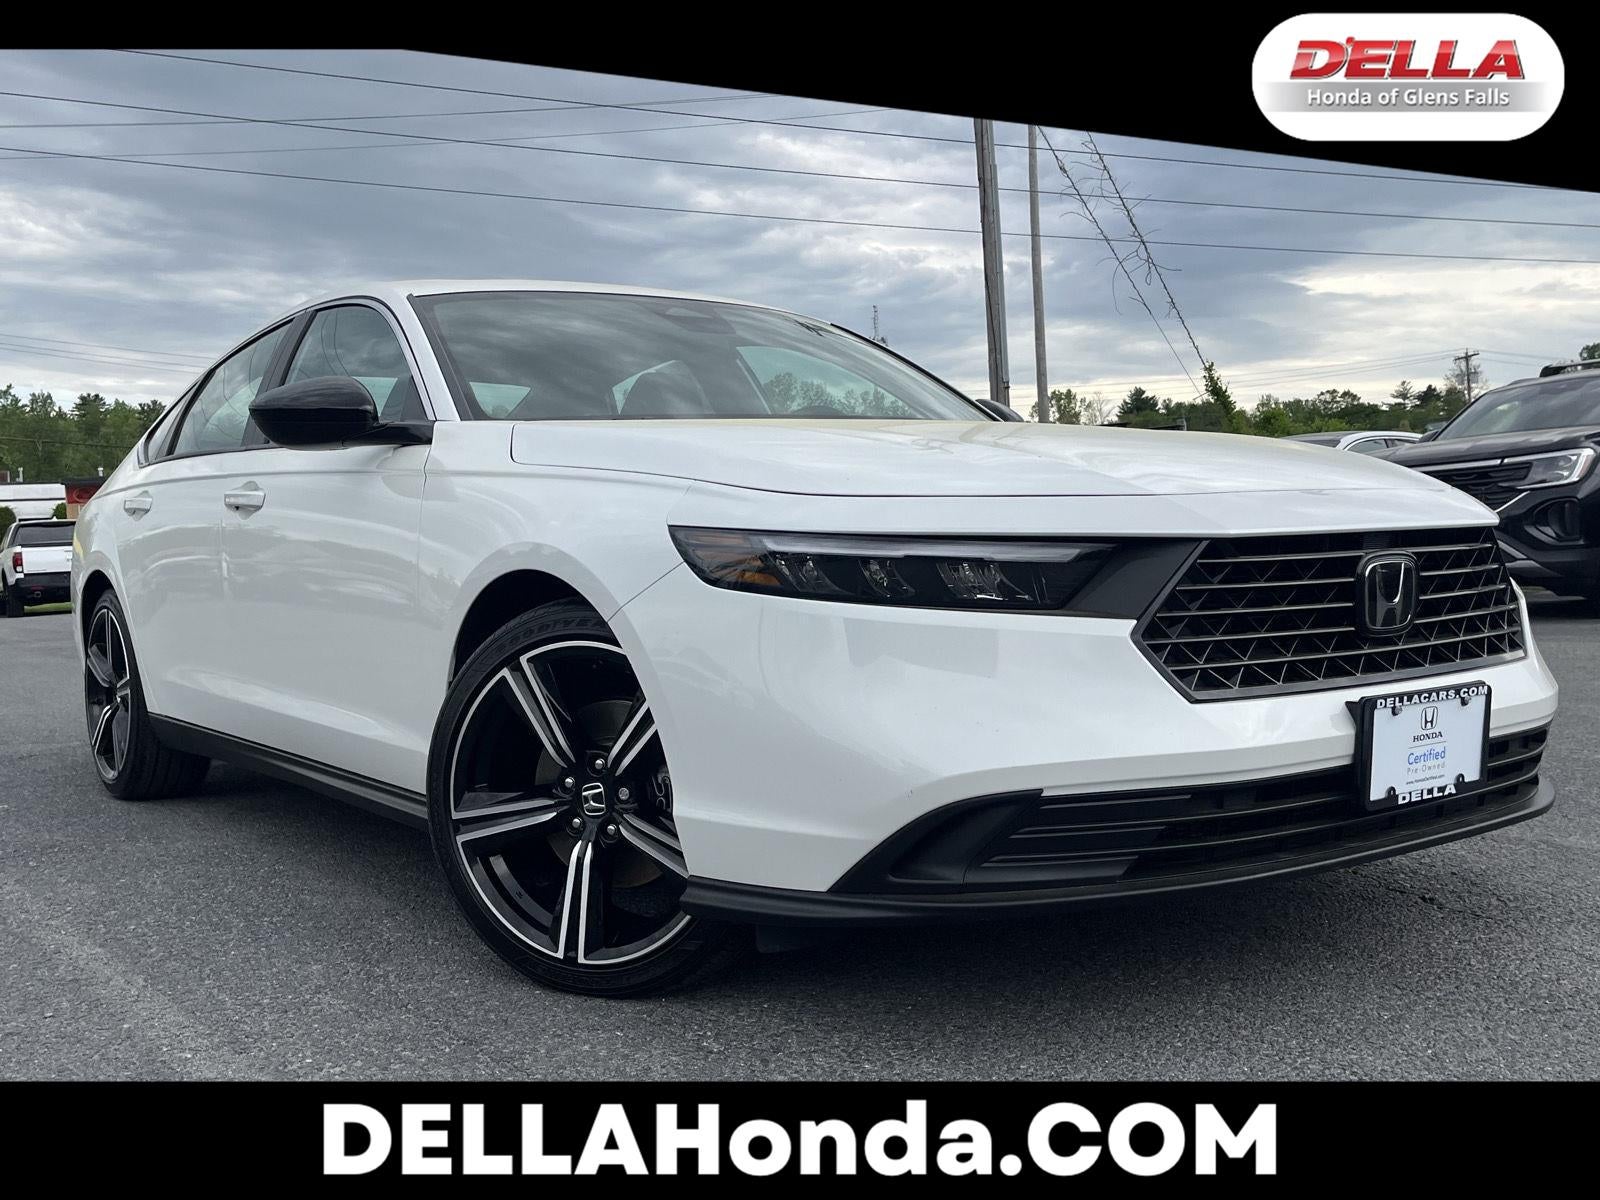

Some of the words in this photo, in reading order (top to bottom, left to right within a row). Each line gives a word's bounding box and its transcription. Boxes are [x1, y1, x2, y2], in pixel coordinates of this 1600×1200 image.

[1376, 685, 1488, 709] DELLACARS.COM
[1412, 731, 1443, 743] HONDA
[1407, 746, 1446, 765] Certified
[1398, 784, 1457, 805] DELLA
